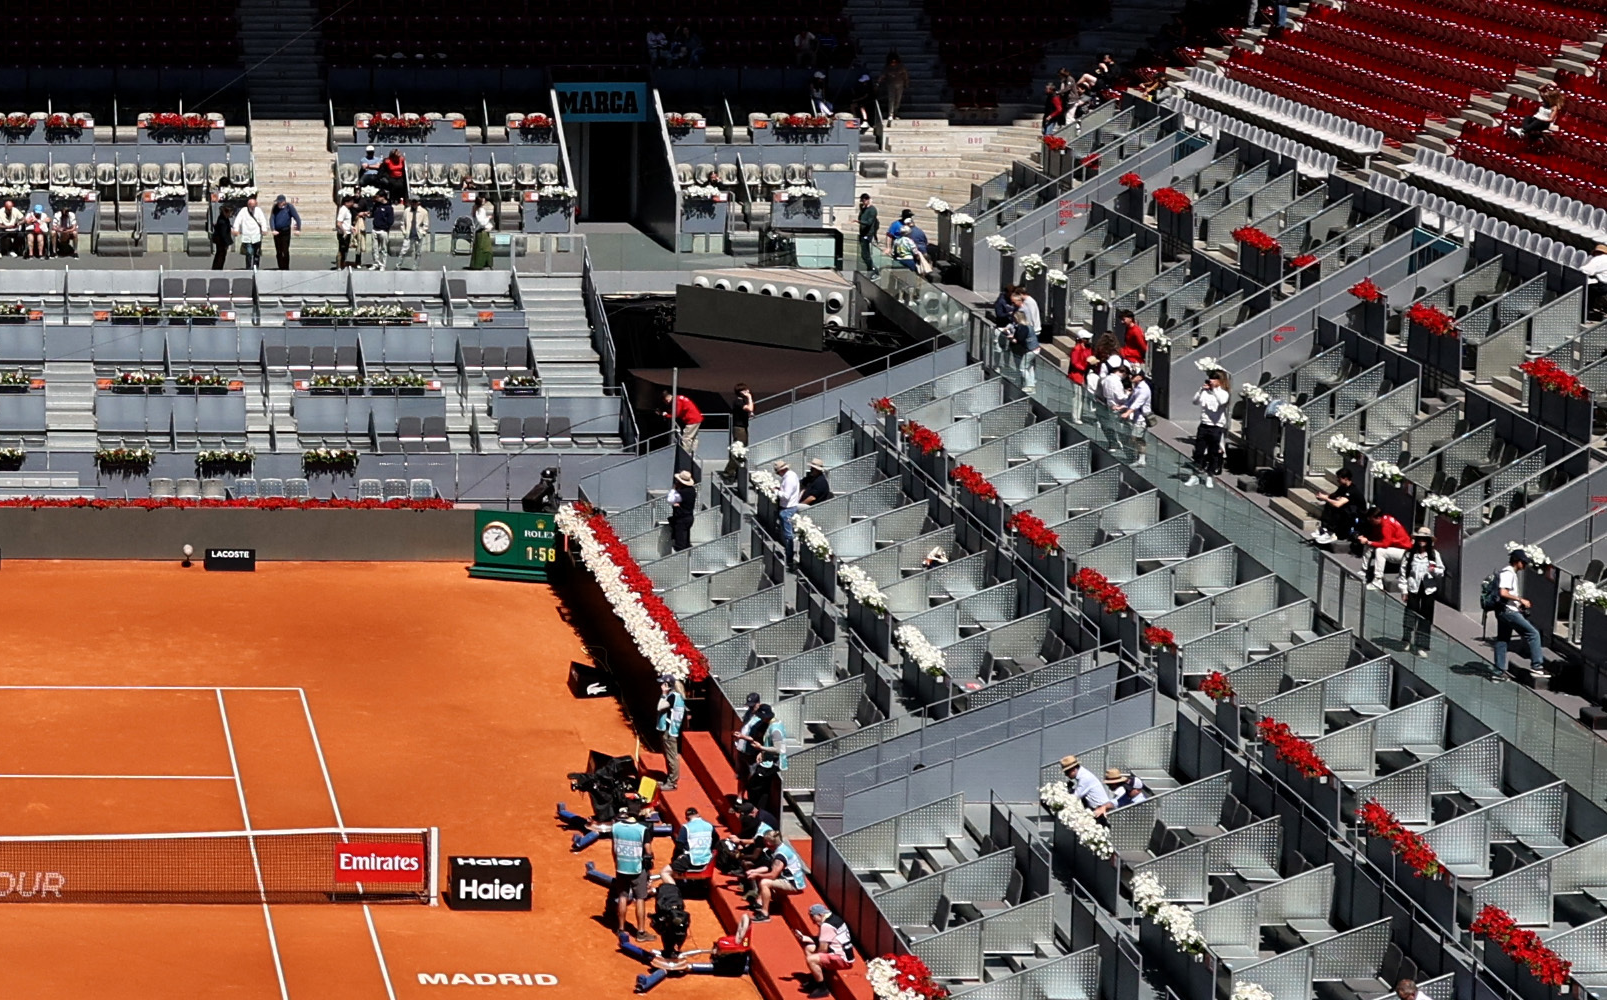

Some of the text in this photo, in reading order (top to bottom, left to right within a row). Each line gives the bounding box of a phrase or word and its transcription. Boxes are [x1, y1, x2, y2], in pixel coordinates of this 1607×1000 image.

[558, 91, 639, 114] MARCA
[211, 550, 250, 558] LACOSTE
[526, 546, 556, 562] 1:58
[339, 853, 419, 871] Emirates
[457, 858, 521, 866] Haier
[459, 878, 524, 900] Haier
[417, 973, 559, 986] MADRID
